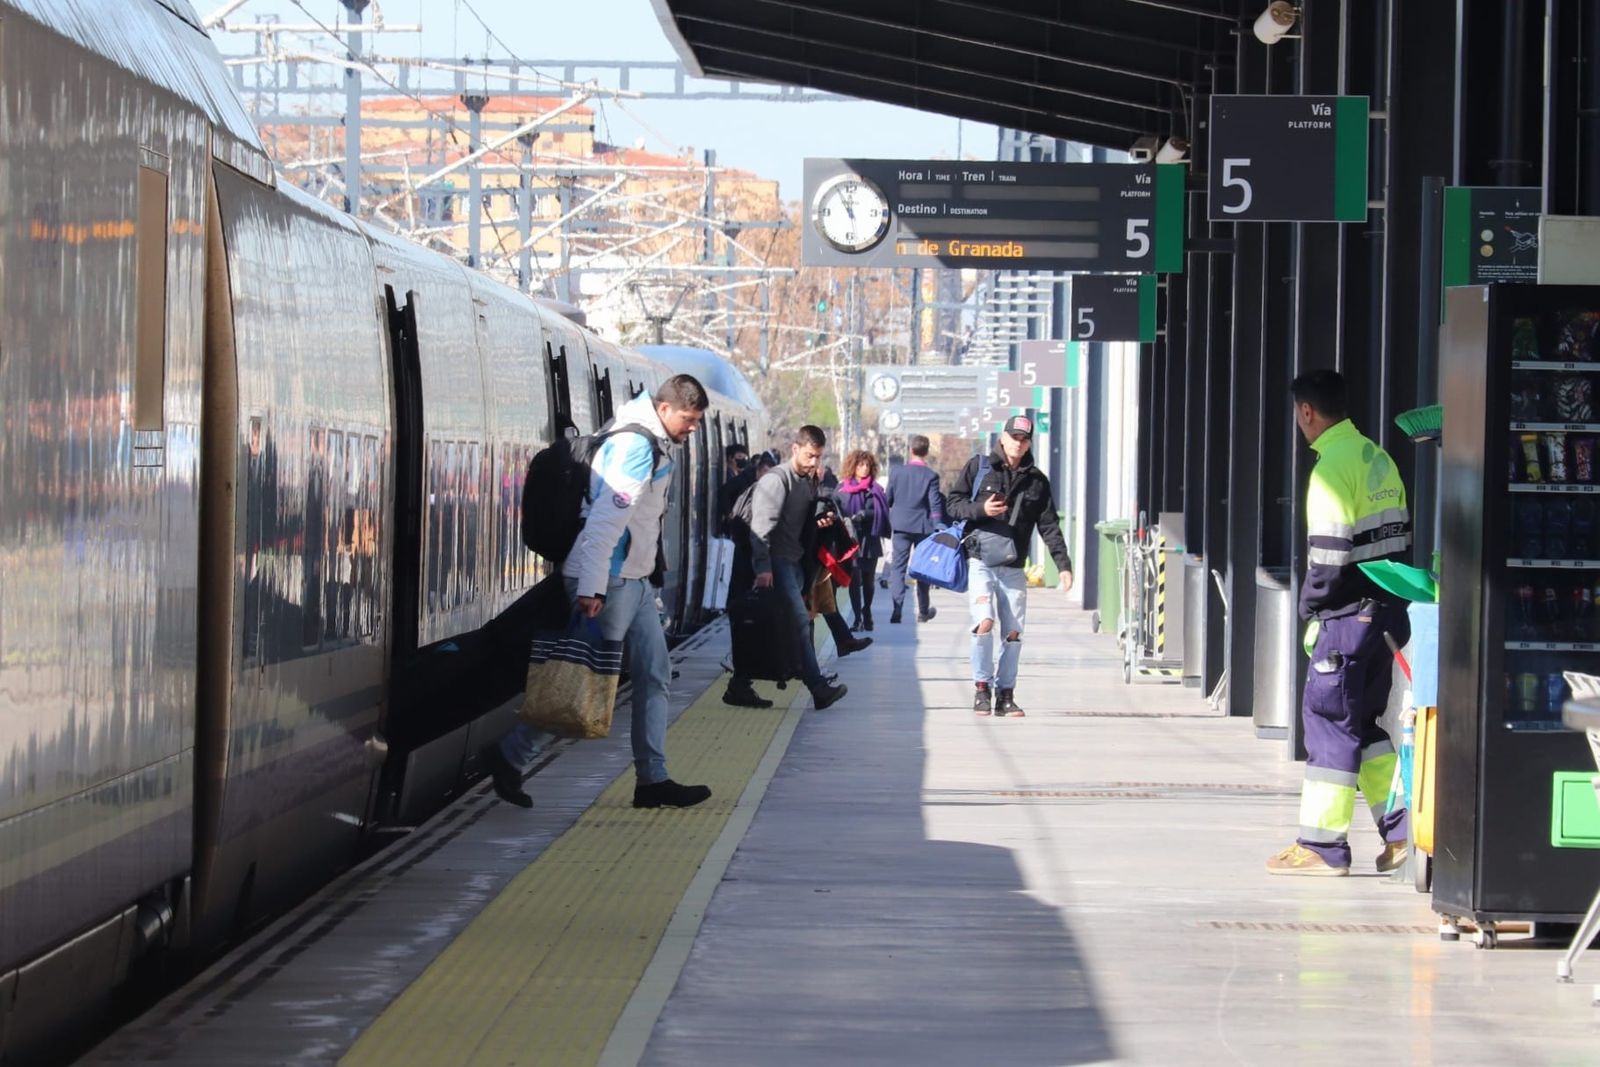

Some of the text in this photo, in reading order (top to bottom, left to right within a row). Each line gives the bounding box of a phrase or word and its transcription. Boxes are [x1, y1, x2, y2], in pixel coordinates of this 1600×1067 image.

[1311, 103, 1332, 116] Vía
[1288, 121, 1331, 129] PLATFORM
[898, 170, 923, 181] Hora
[962, 171, 985, 181] Tren
[1135, 173, 1151, 184] Vía
[1222, 158, 1253, 214] 5
[1120, 190, 1151, 198] PLATFORM
[898, 204, 937, 215] Destino
[1126, 218, 1150, 259] 5
[917, 239, 939, 256] de
[949, 240, 1024, 257] Granada
[1078, 307, 1095, 338] 5
[1023, 362, 1037, 385] 5
[986, 387, 998, 404] 5
[999, 389, 1010, 406] 5
[983, 407, 992, 421] 5
[960, 426, 967, 438] 5
[971, 418, 979, 432] 5
